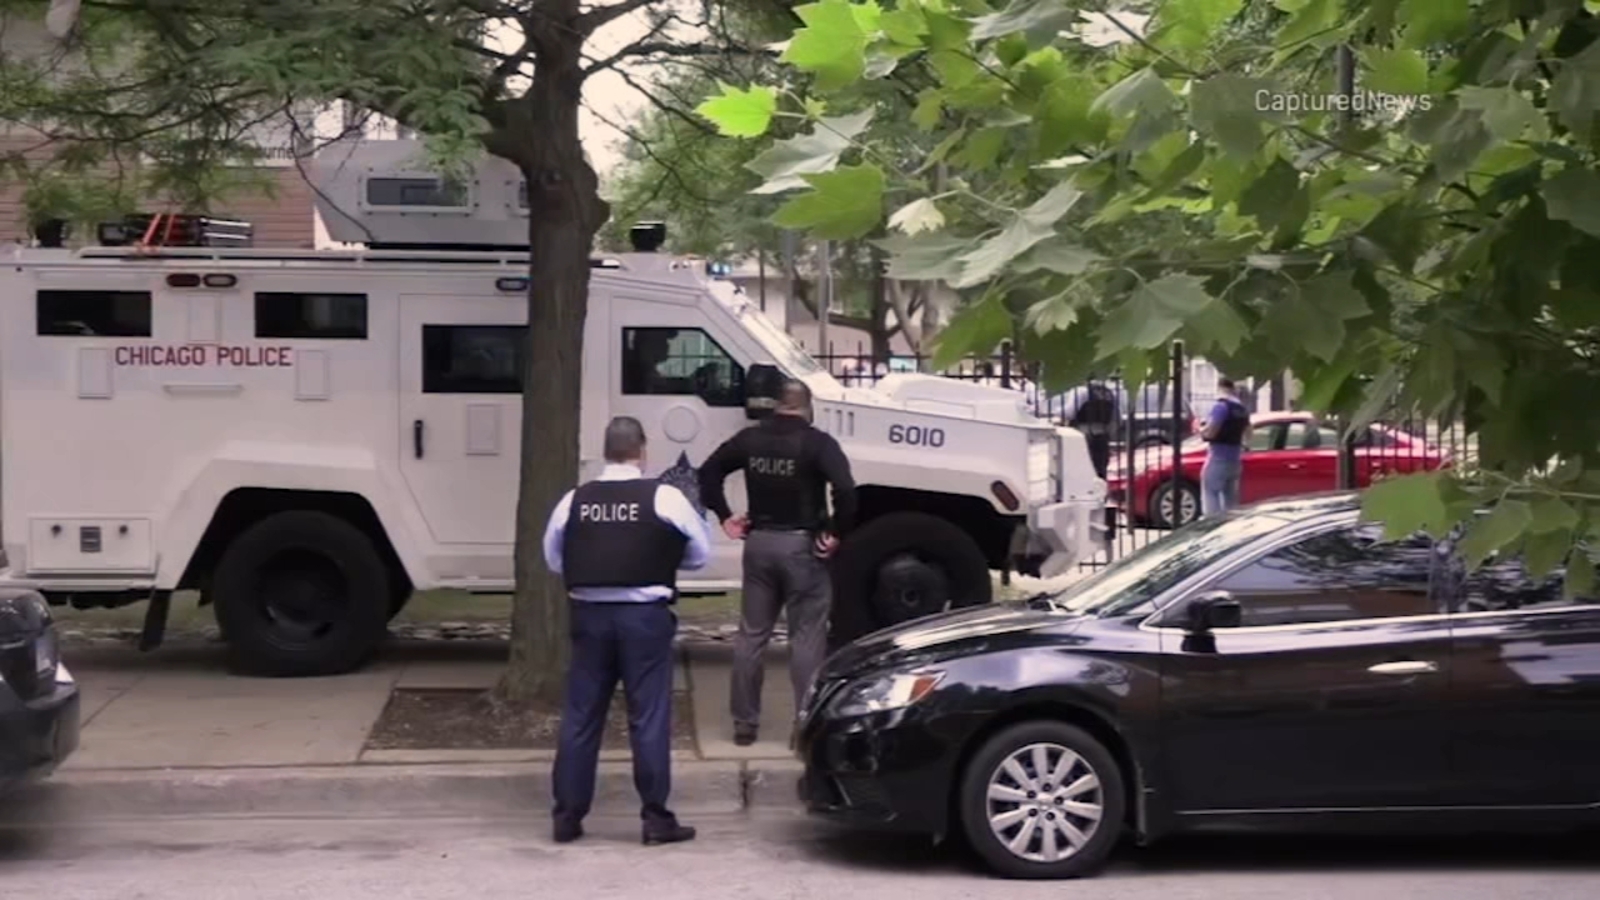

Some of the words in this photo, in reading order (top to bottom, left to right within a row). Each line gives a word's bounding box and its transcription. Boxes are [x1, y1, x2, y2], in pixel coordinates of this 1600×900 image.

[115, 346, 206, 366] CHICAGO
[217, 346, 293, 366] POLICE
[889, 424, 945, 447] 6010
[749, 457, 795, 475] POLICE
[580, 503, 639, 521] POLICE
